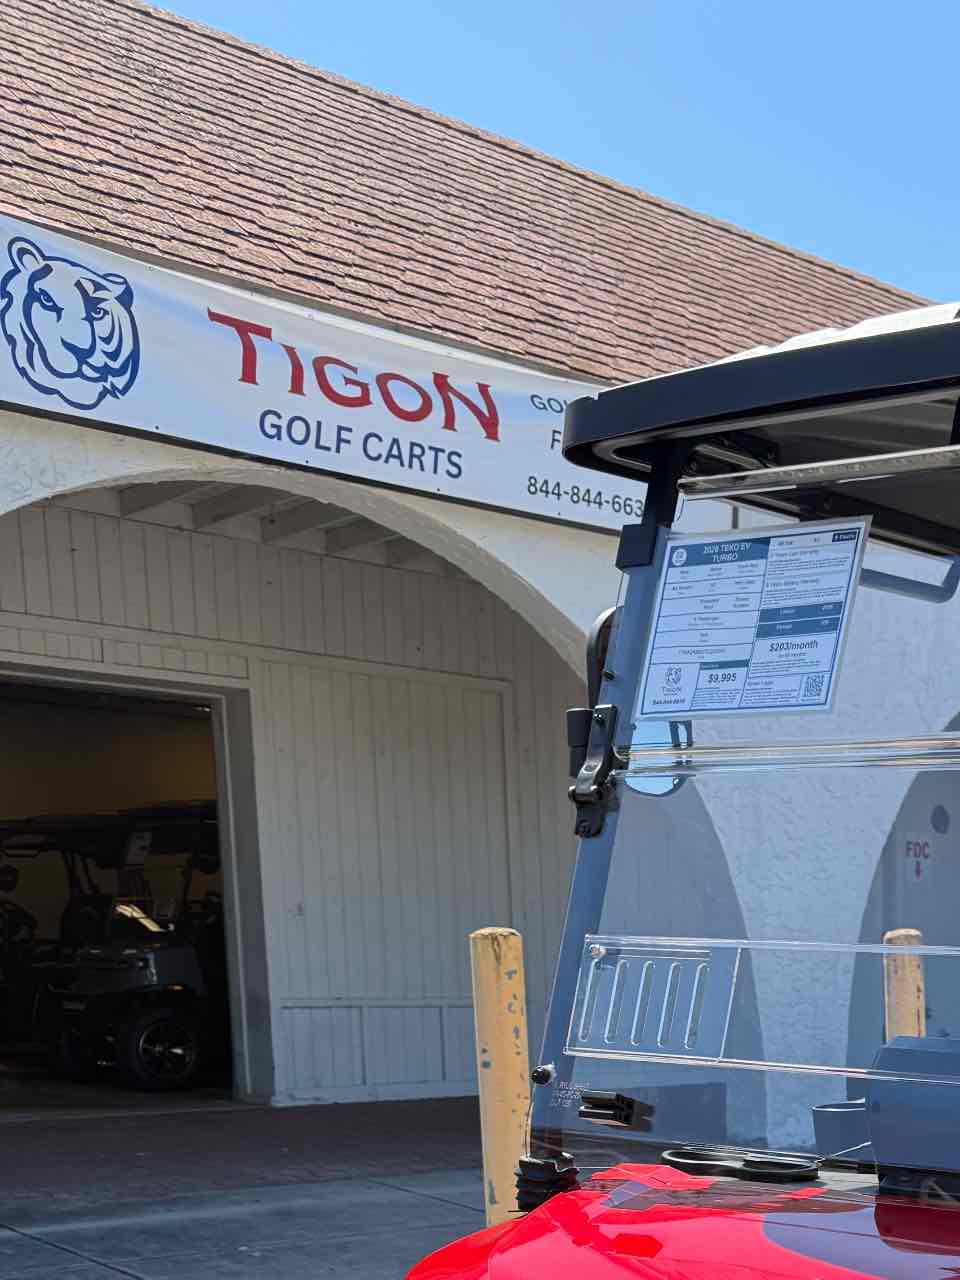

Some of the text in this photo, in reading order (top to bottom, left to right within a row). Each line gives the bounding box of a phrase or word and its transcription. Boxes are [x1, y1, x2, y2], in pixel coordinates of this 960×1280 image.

[208, 307, 500, 442] TIGON
[259, 409, 464, 479] GOLF CARTS
[528, 476, 645, 517] 844-844-663
[906, 841, 930, 859] FDC
